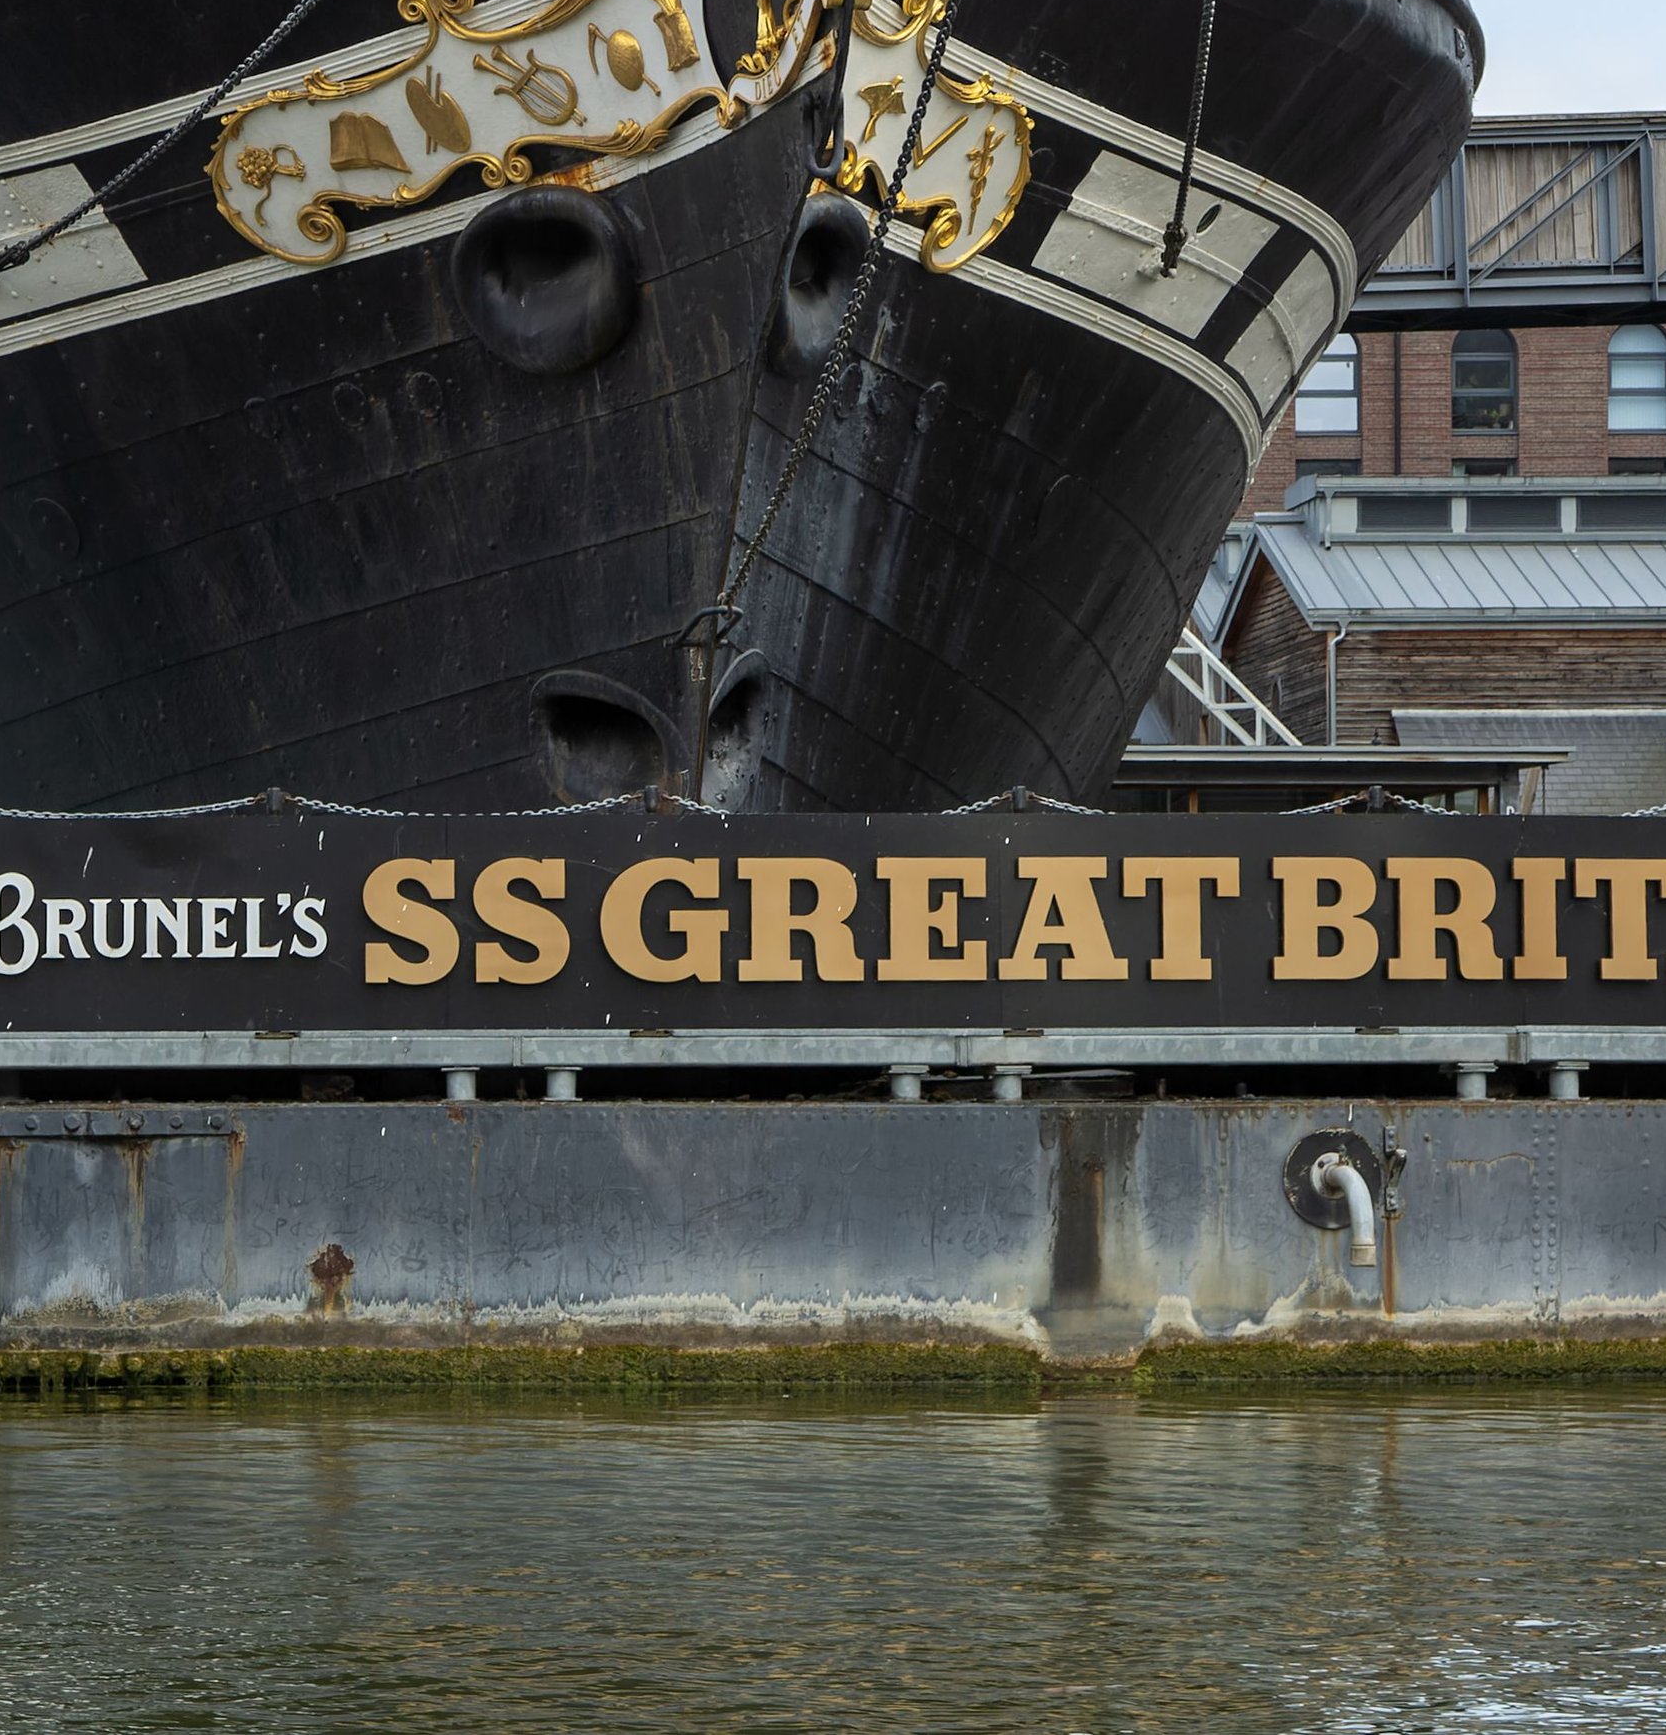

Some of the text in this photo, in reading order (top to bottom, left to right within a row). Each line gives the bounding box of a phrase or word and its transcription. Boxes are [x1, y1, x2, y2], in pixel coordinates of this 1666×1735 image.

[755, 63, 781, 100] DIEU
[363, 857, 571, 985] SS
[599, 857, 1241, 983] GREAT
